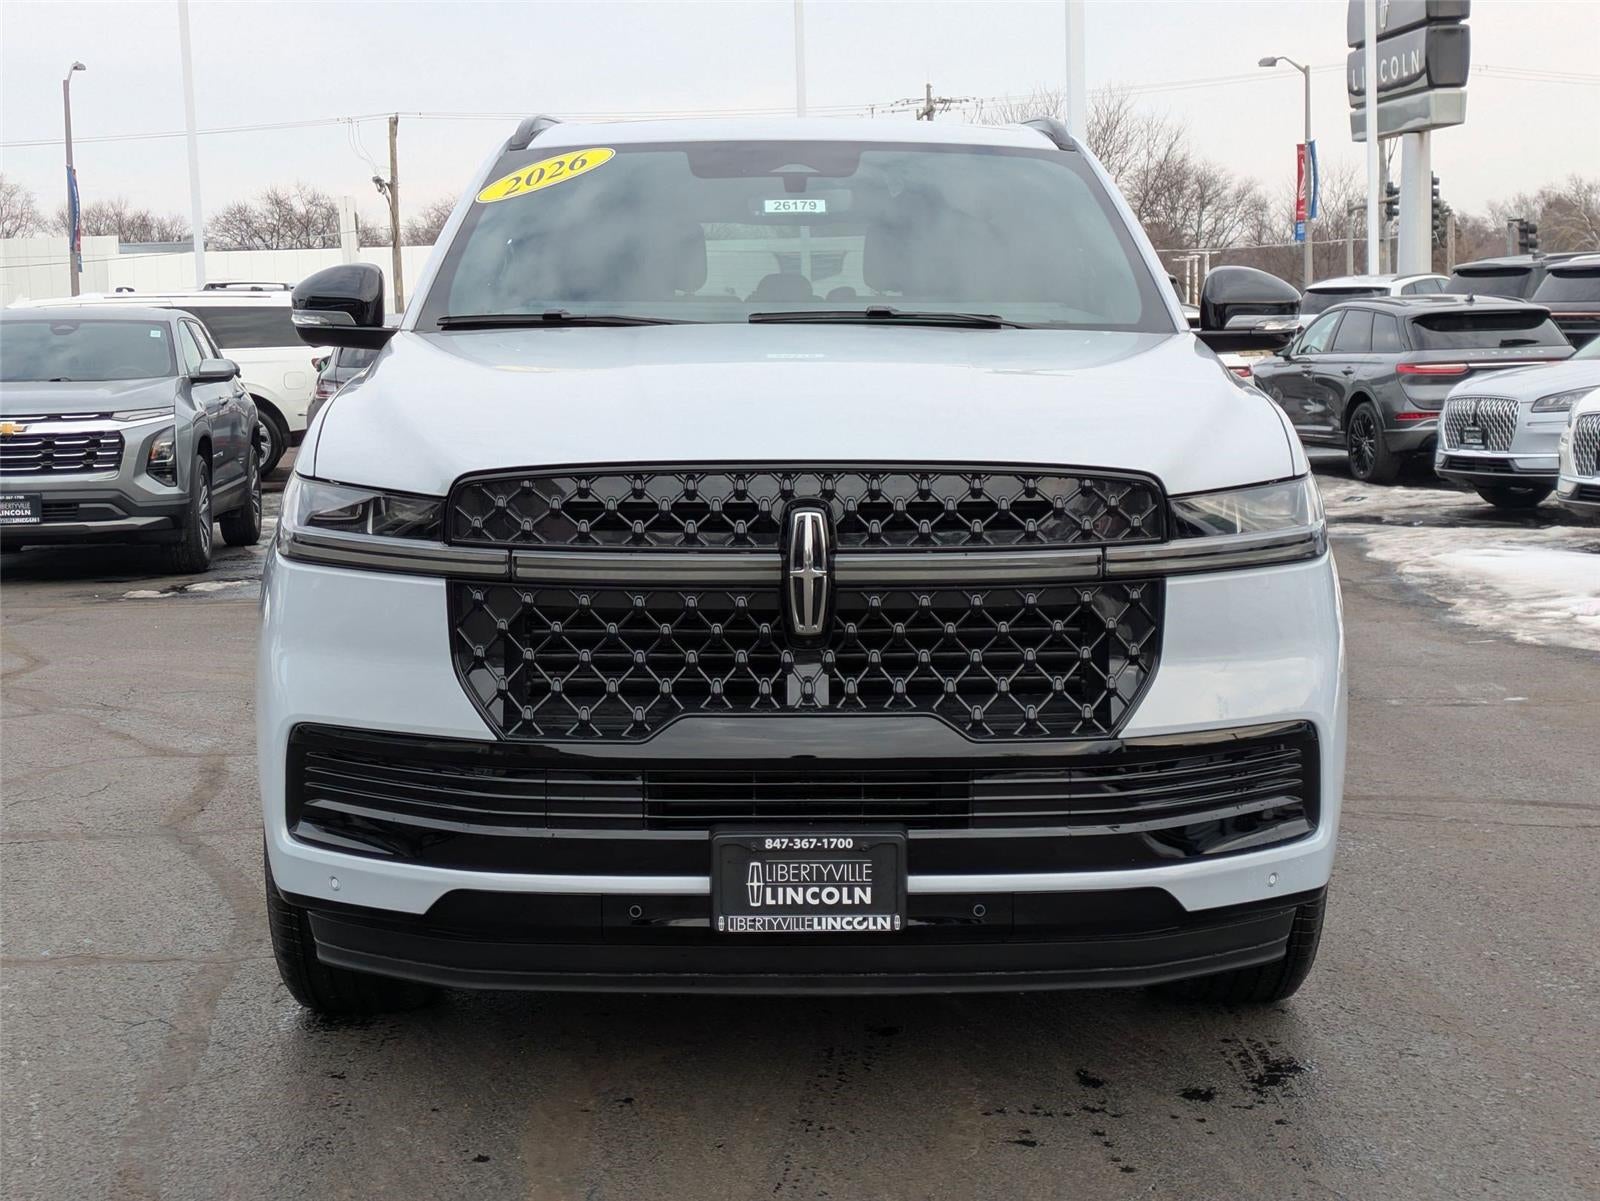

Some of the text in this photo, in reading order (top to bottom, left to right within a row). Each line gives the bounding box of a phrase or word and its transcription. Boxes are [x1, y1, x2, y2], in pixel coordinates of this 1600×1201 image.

[1352, 48, 1419, 91] LICOLN
[503, 152, 588, 196] 2026
[773, 200, 817, 211] 26179
[764, 838, 853, 849] 847-367-1700
[765, 863, 872, 882] LIBERTYVILLE
[765, 887, 872, 905] LINCOLN
